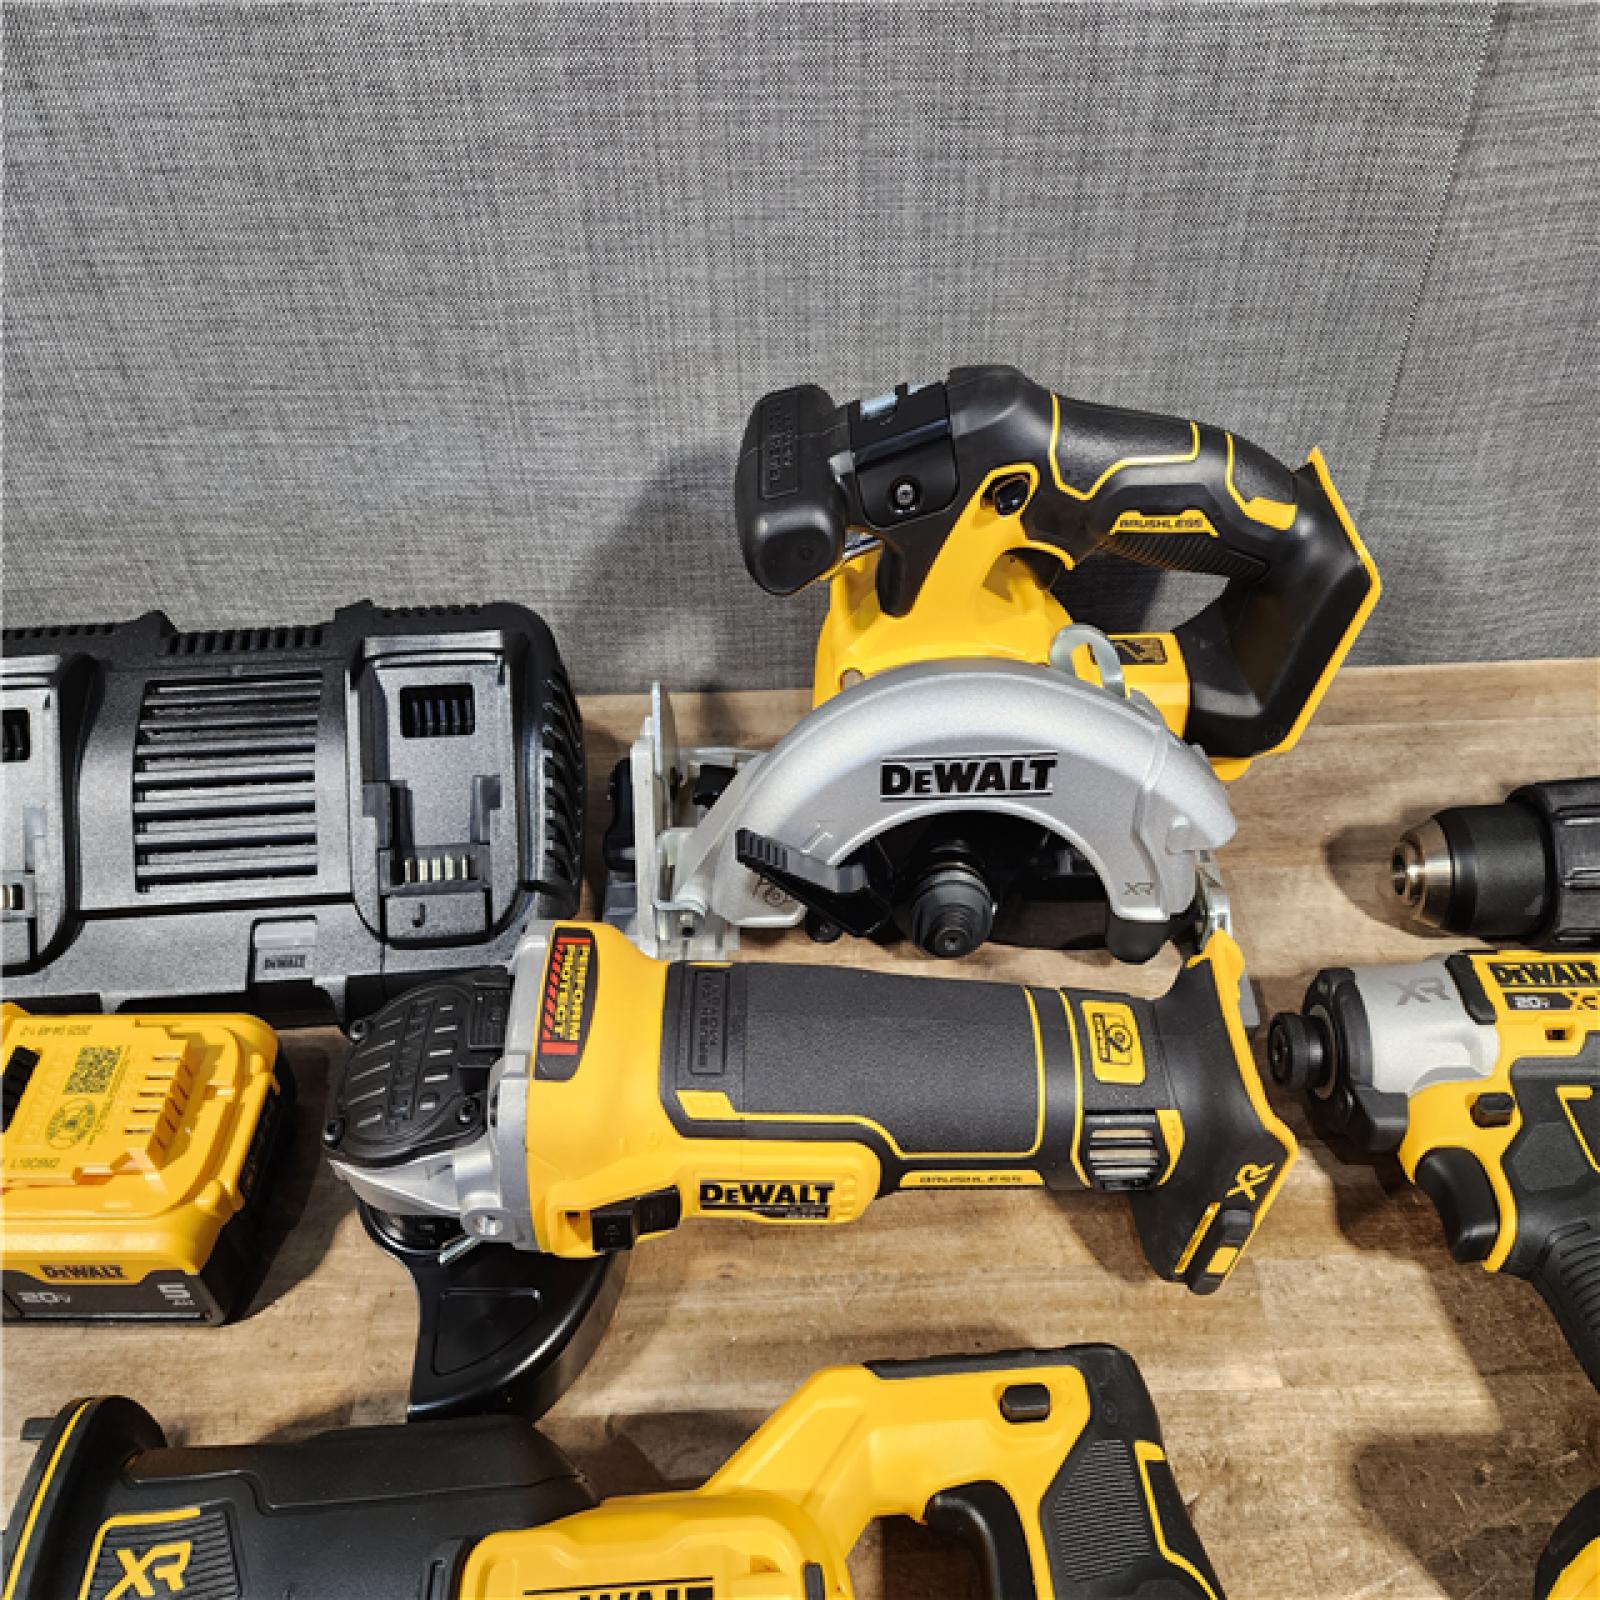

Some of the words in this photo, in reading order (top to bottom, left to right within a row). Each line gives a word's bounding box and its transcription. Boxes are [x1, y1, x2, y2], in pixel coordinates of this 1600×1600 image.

[882, 759, 1058, 796] DEWALT
[1390, 976, 1451, 1006] XR
[699, 1182, 835, 1204] DEWALT
[1225, 1161, 1275, 1202] XR
[156, 1281, 191, 1299] 5
[103, 1540, 192, 1600] XR
